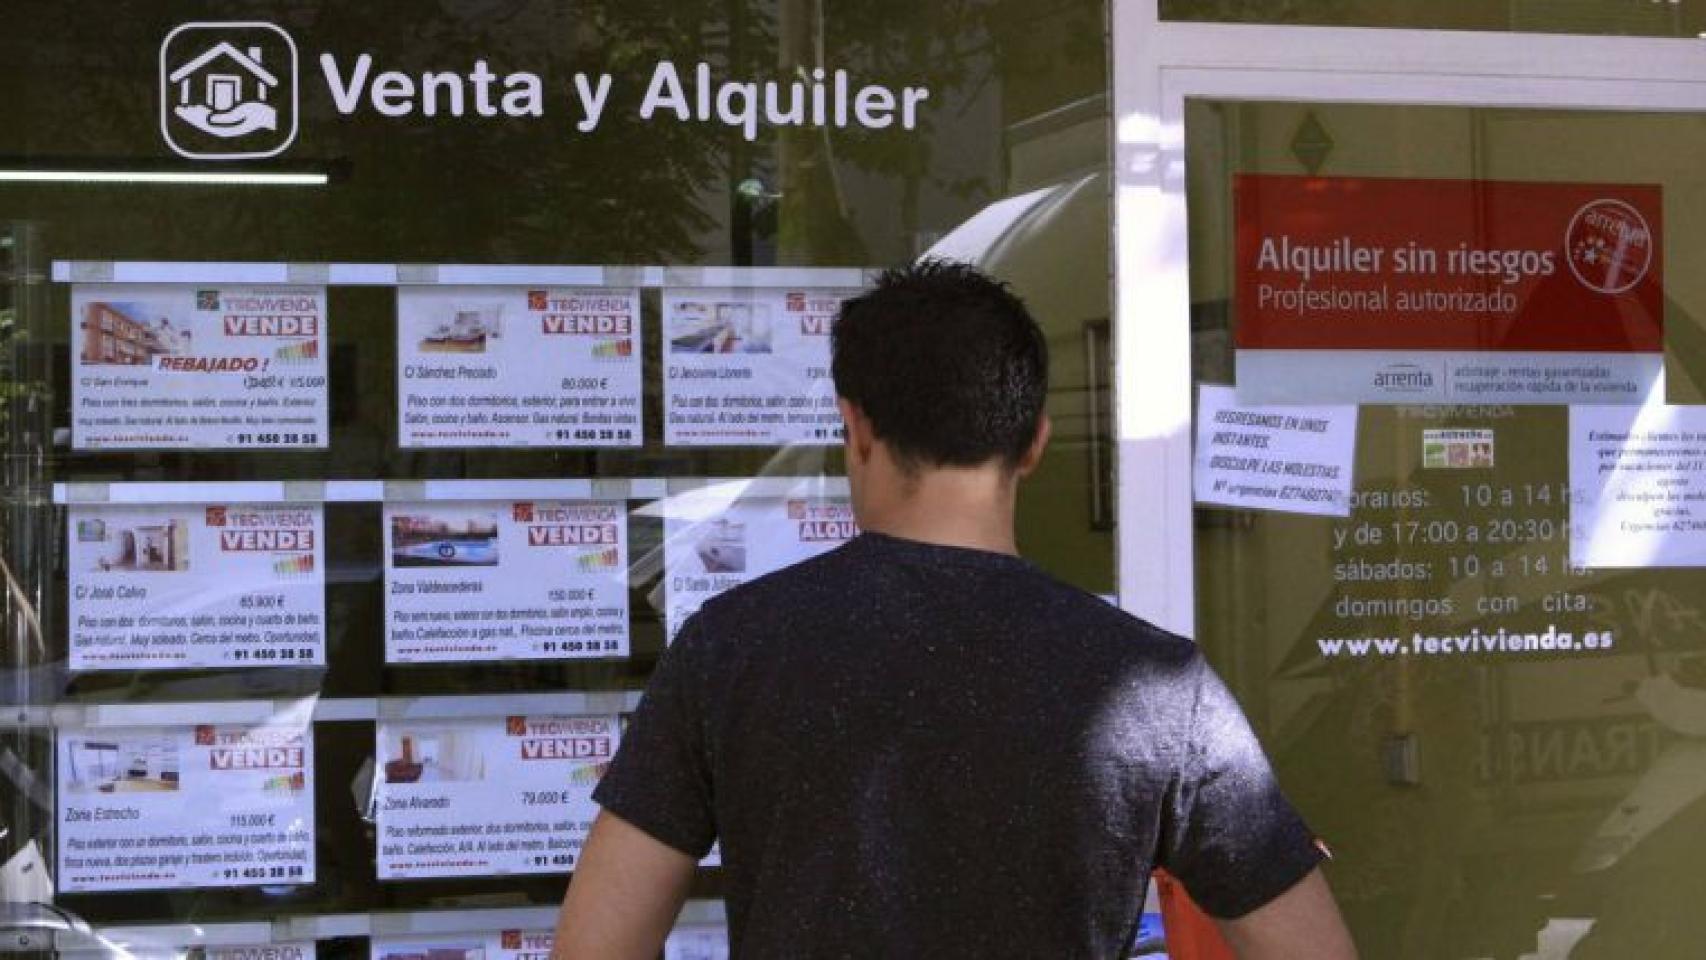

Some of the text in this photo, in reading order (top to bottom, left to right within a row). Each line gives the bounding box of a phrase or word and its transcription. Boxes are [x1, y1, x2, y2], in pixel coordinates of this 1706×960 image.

[321, 54, 929, 141] Venta y Alquiler
[1257, 235, 1556, 285] Alquiler sin riesgos
[1259, 283, 1518, 316] Profesional autorizado
[225, 315, 316, 336] VENDE
[544, 315, 631, 334] VENDE
[158, 357, 259, 372] REBAJADO
[1374, 371, 1433, 388] arrenta
[1461, 484, 1492, 507] 10
[1501, 490, 1513, 506] a
[1523, 484, 1550, 505] 14
[223, 530, 313, 550] VENDE
[529, 526, 617, 545] VENDE
[1333, 526, 1347, 551] y
[1355, 521, 1382, 546] de
[1392, 520, 1459, 545] 17:00
[1466, 528, 1479, 542] a
[1488, 519, 1553, 542] 20:30
[1335, 553, 1433, 582] sábados:
[1450, 553, 1479, 578] 10
[1493, 559, 1504, 577] a
[1523, 552, 1549, 576] 14
[116, 585, 147, 600] Calvo
[1336, 594, 1455, 620] domingos
[1477, 596, 1519, 615] con
[1318, 625, 1613, 657] www.tecvivienda.es
[211, 748, 304, 770] VENDE
[522, 738, 609, 760] VENDE
[384, 797, 408, 811] Zona
[522, 791, 559, 805] 79.000
[65, 808, 92, 822] Zona
